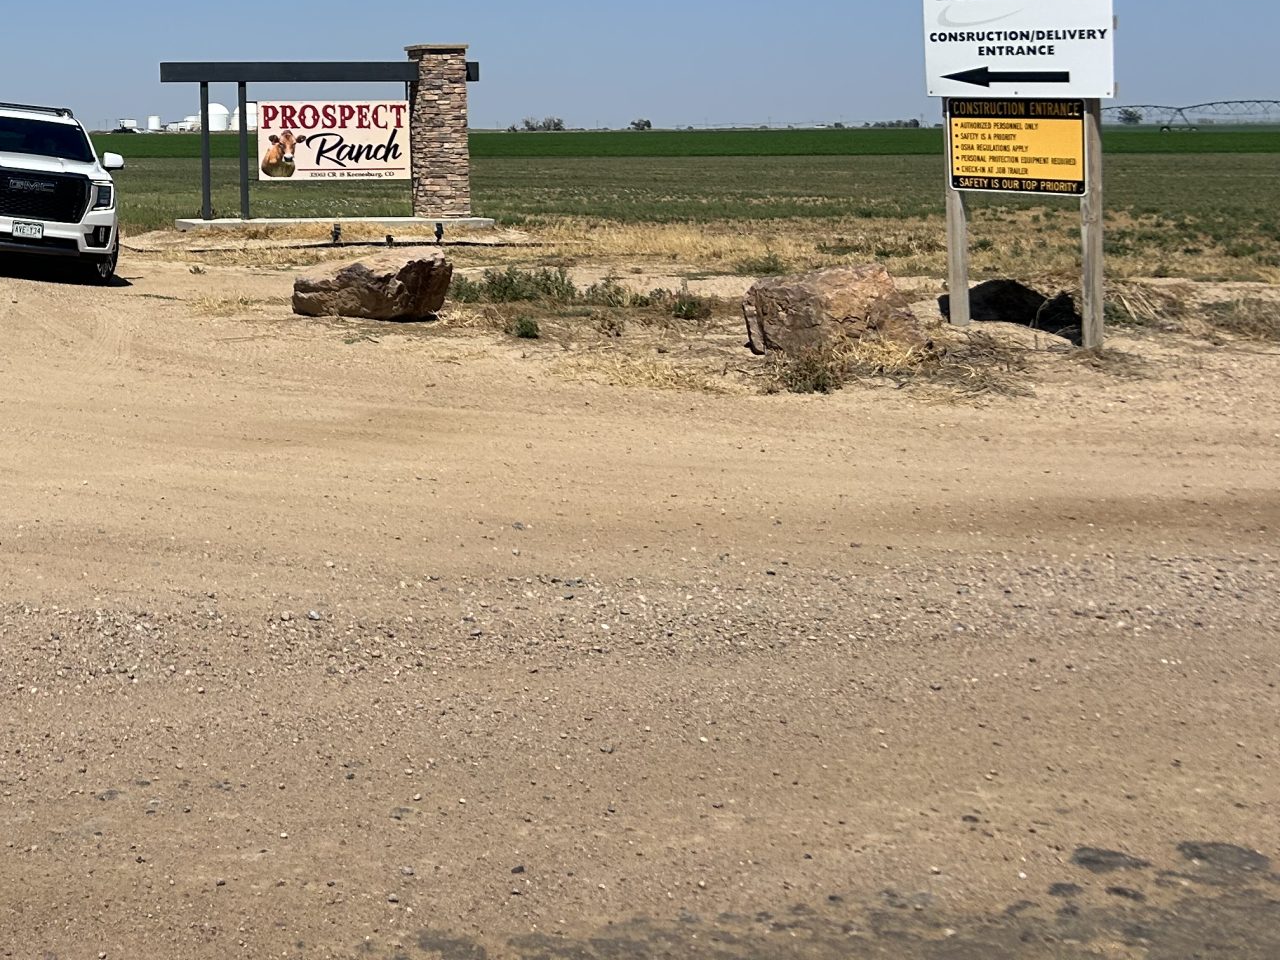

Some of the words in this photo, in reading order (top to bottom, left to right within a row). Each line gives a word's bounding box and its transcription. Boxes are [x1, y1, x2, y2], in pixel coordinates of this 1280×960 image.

[929, 28, 1107, 42] CONSRUCTION/DELIVERY
[978, 45, 1055, 56] ENTRANCE
[953, 102, 1025, 115] CONSTRUCTION
[1030, 102, 1080, 116] ENTRANCE
[261, 104, 406, 130] PROSPECT
[306, 128, 402, 167] Ranch
[9, 180, 55, 192] GMC
[959, 178, 988, 187] SAFETY
[991, 179, 999, 188] IS
[1002, 180, 1019, 189] OUR
[1022, 181, 1038, 190] TOP
[1041, 182, 1077, 191] PRIORITY
